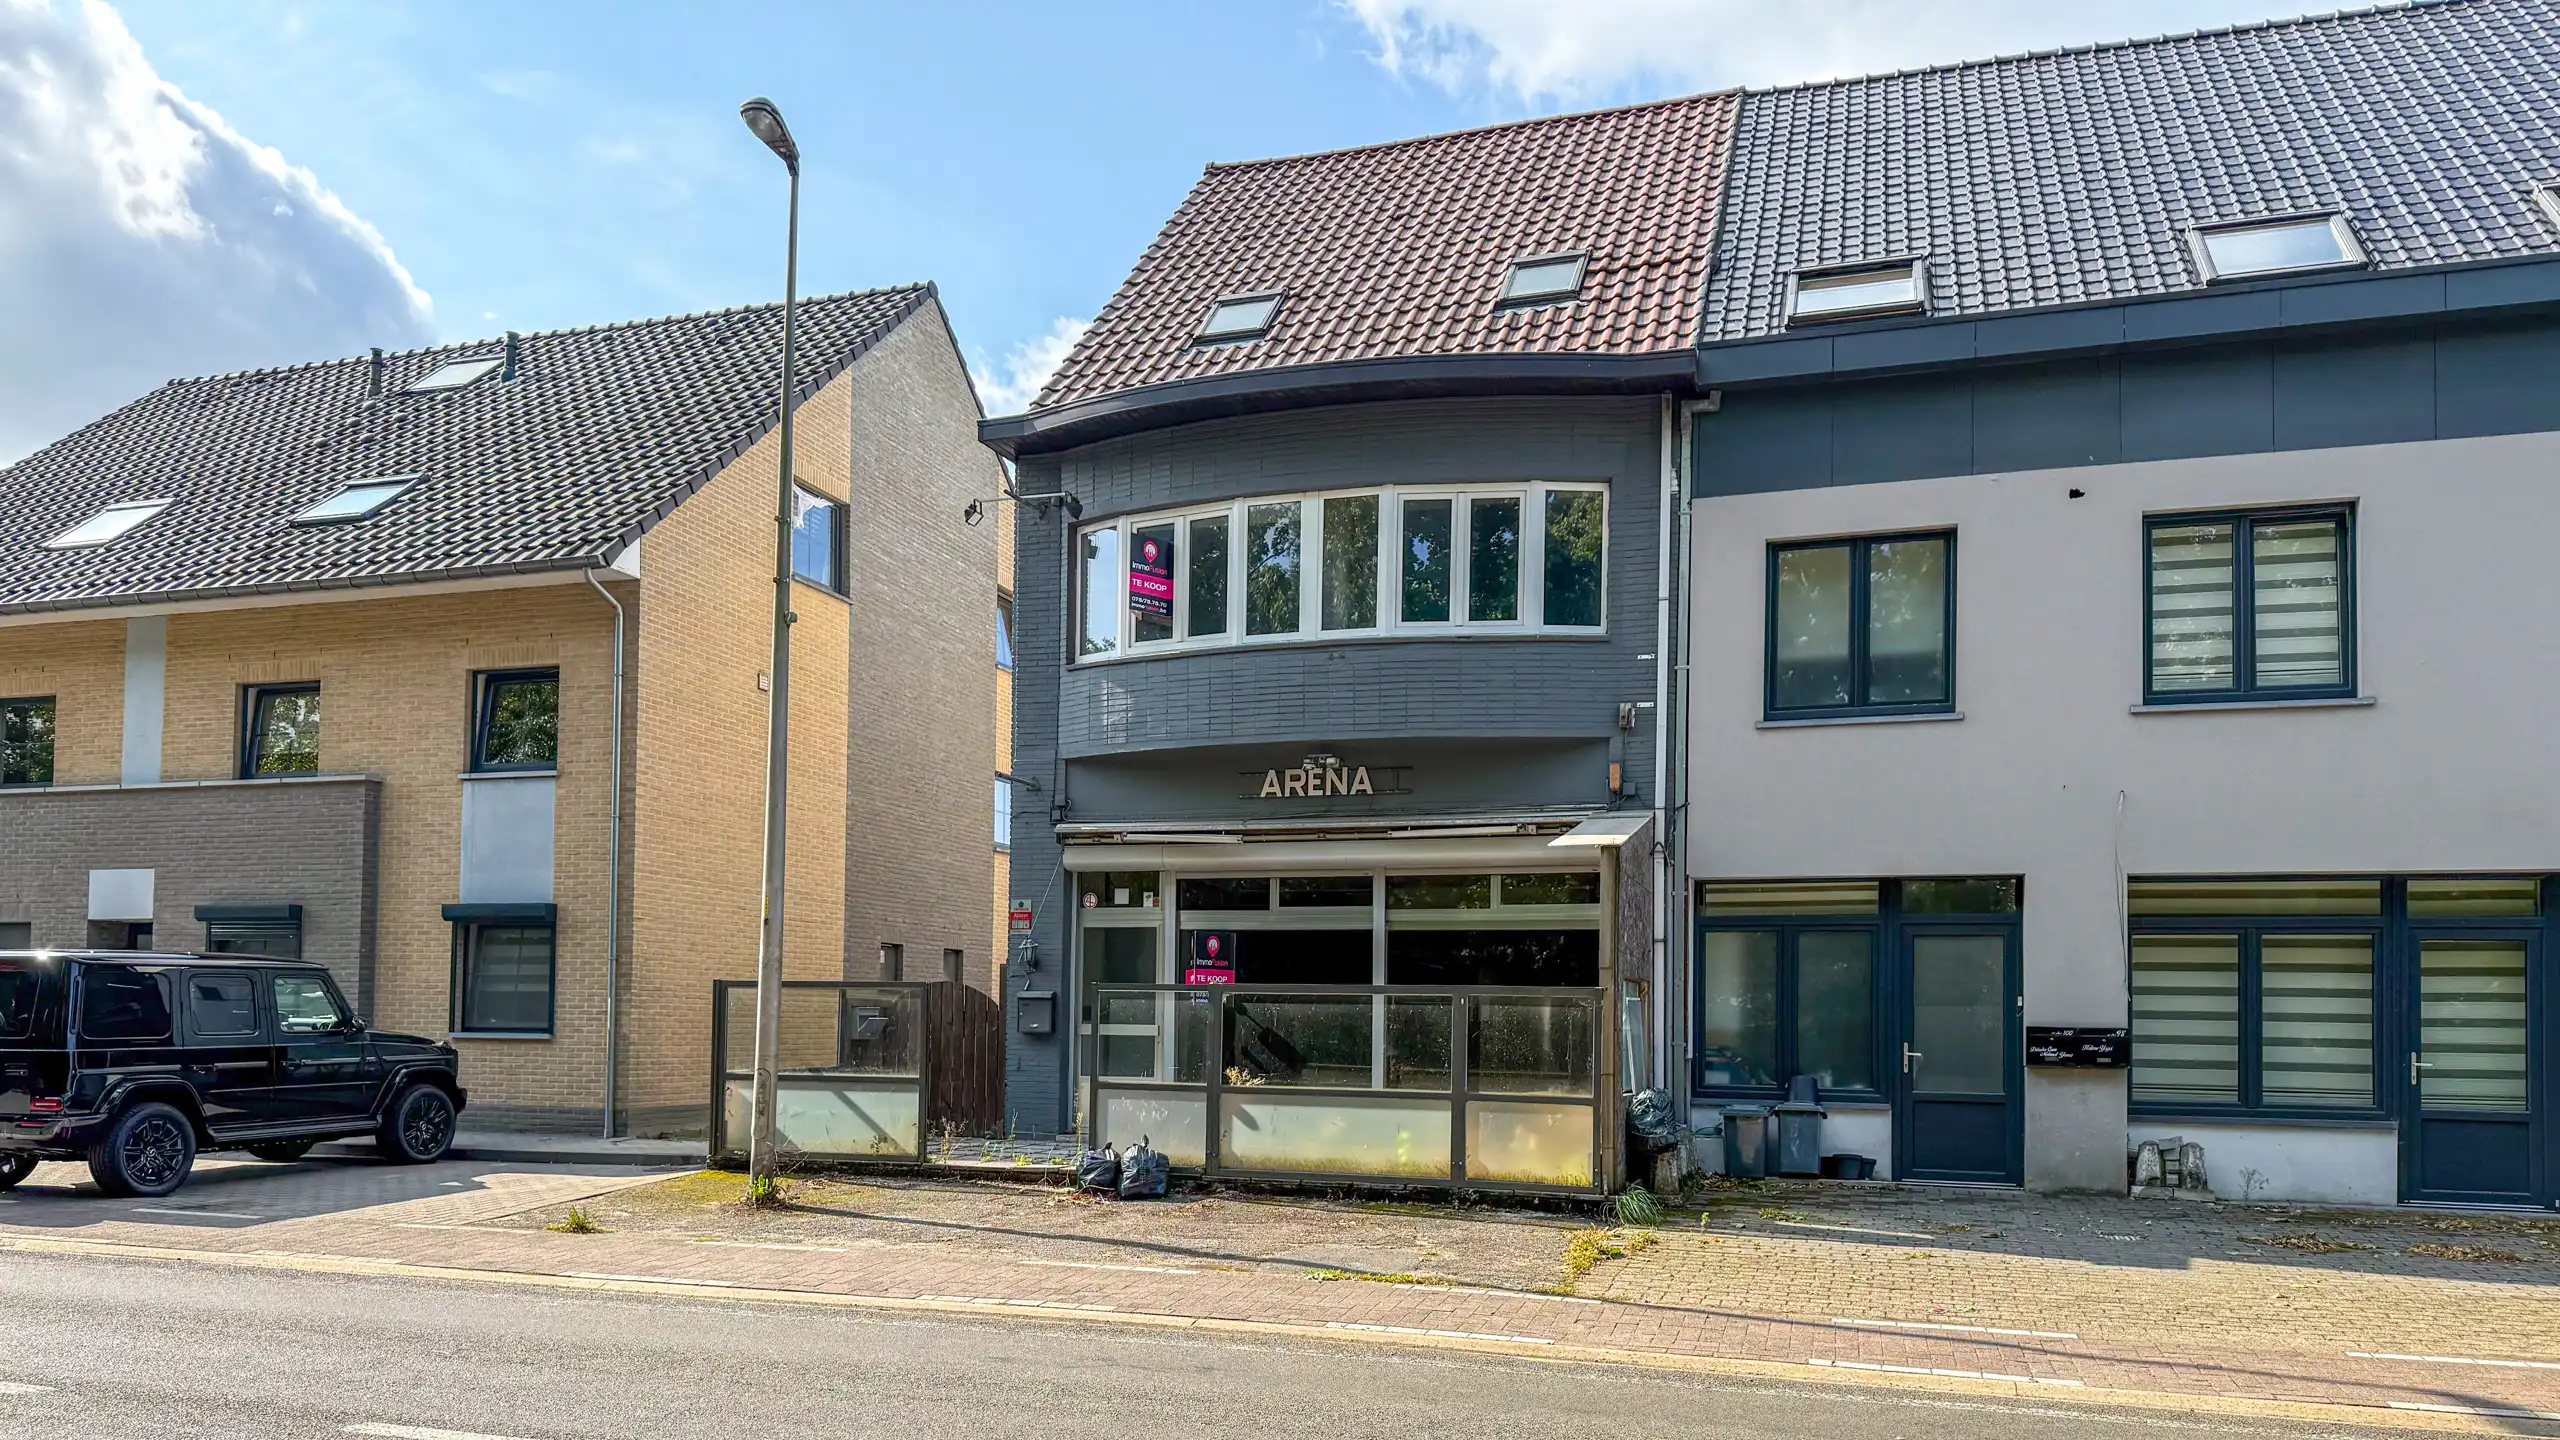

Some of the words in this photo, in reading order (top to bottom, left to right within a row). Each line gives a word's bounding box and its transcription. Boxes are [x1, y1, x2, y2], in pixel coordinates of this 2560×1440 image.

[1132, 578, 1142, 587] TE
[1144, 581, 1167, 591] KOOP
[1260, 766, 1374, 798] ARENA
[1207, 975, 1228, 983] KOOP
[2116, 1029, 2127, 1037] 98
